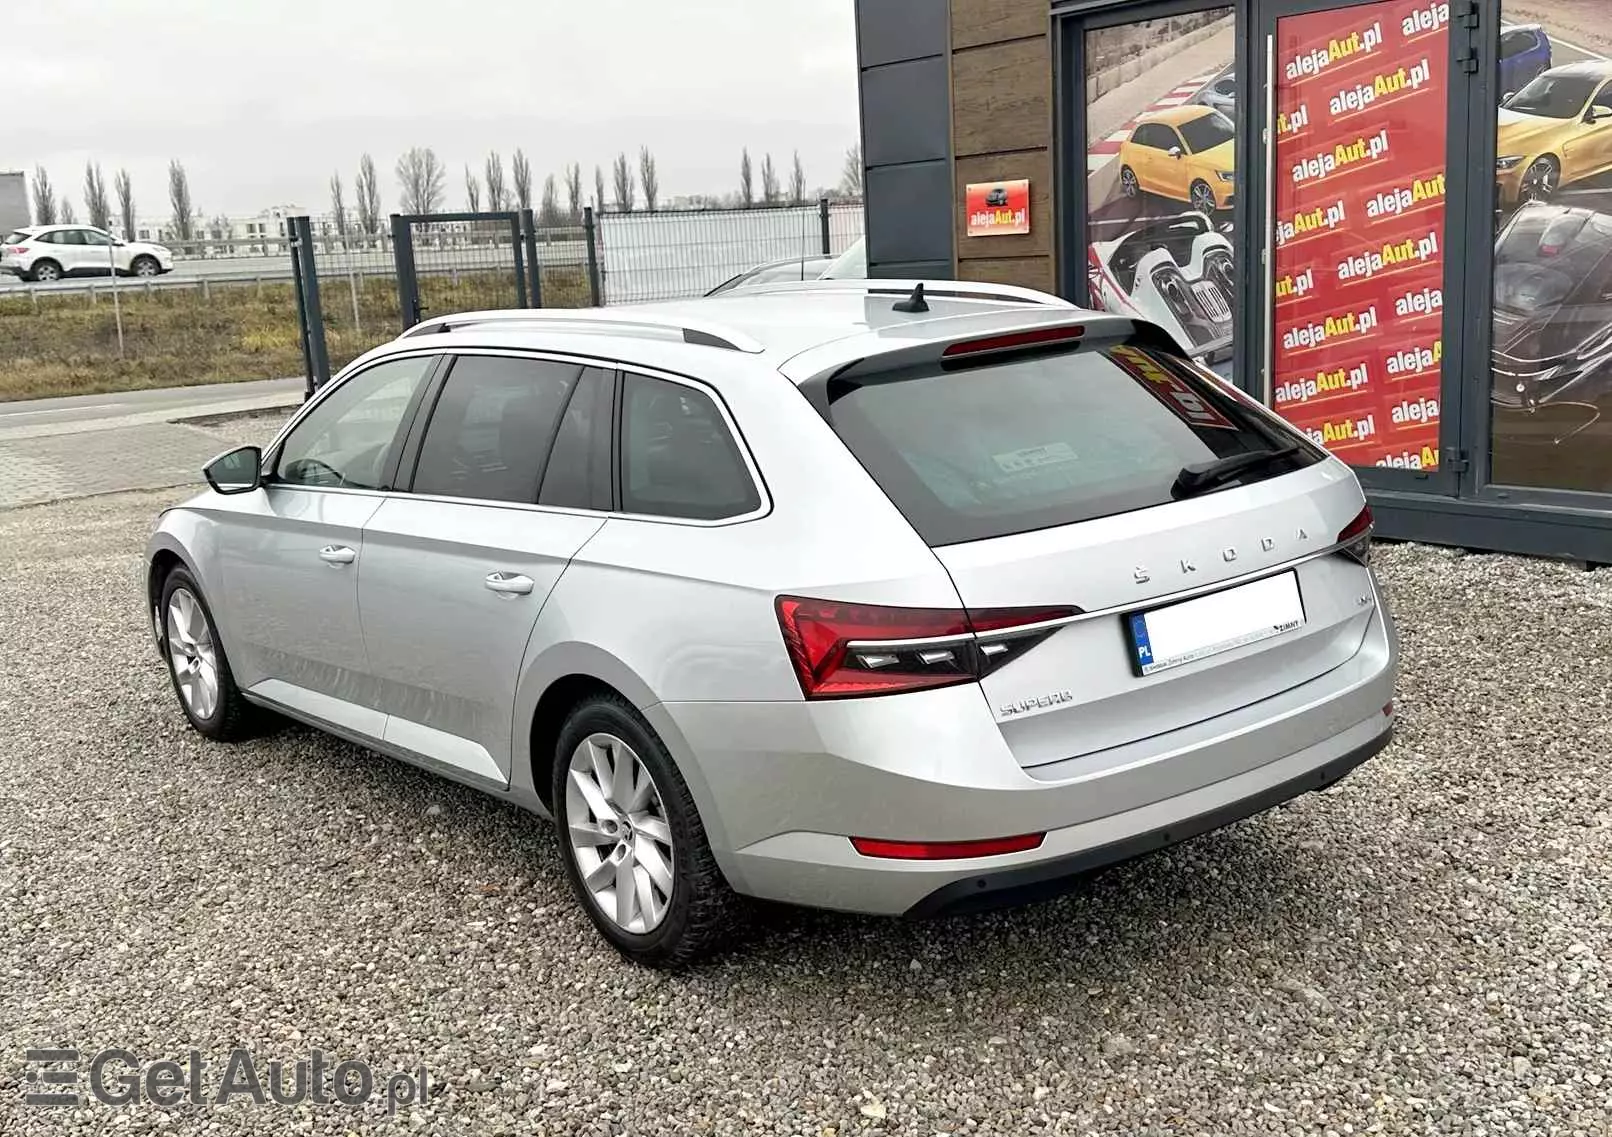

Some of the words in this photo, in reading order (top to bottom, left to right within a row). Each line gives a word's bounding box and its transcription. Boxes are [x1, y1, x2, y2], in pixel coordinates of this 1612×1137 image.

[1286, 22, 1383, 80] alejaAut.pl
[1329, 58, 1430, 116] alejaAut.pl
[1292, 130, 1389, 183] alejaAut.pl
[970, 208, 1026, 228] alejaAut.pl
[1276, 199, 1346, 246] jaAut.pl
[1337, 231, 1438, 280] alejaAut.pl
[1395, 287, 1443, 316] aleja
[1283, 306, 1378, 350] alejaAut.pl
[1275, 363, 1369, 403] alejaAut.pl
[1138, 646, 1152, 658] PL
[1000, 690, 1073, 716] SUPERB
